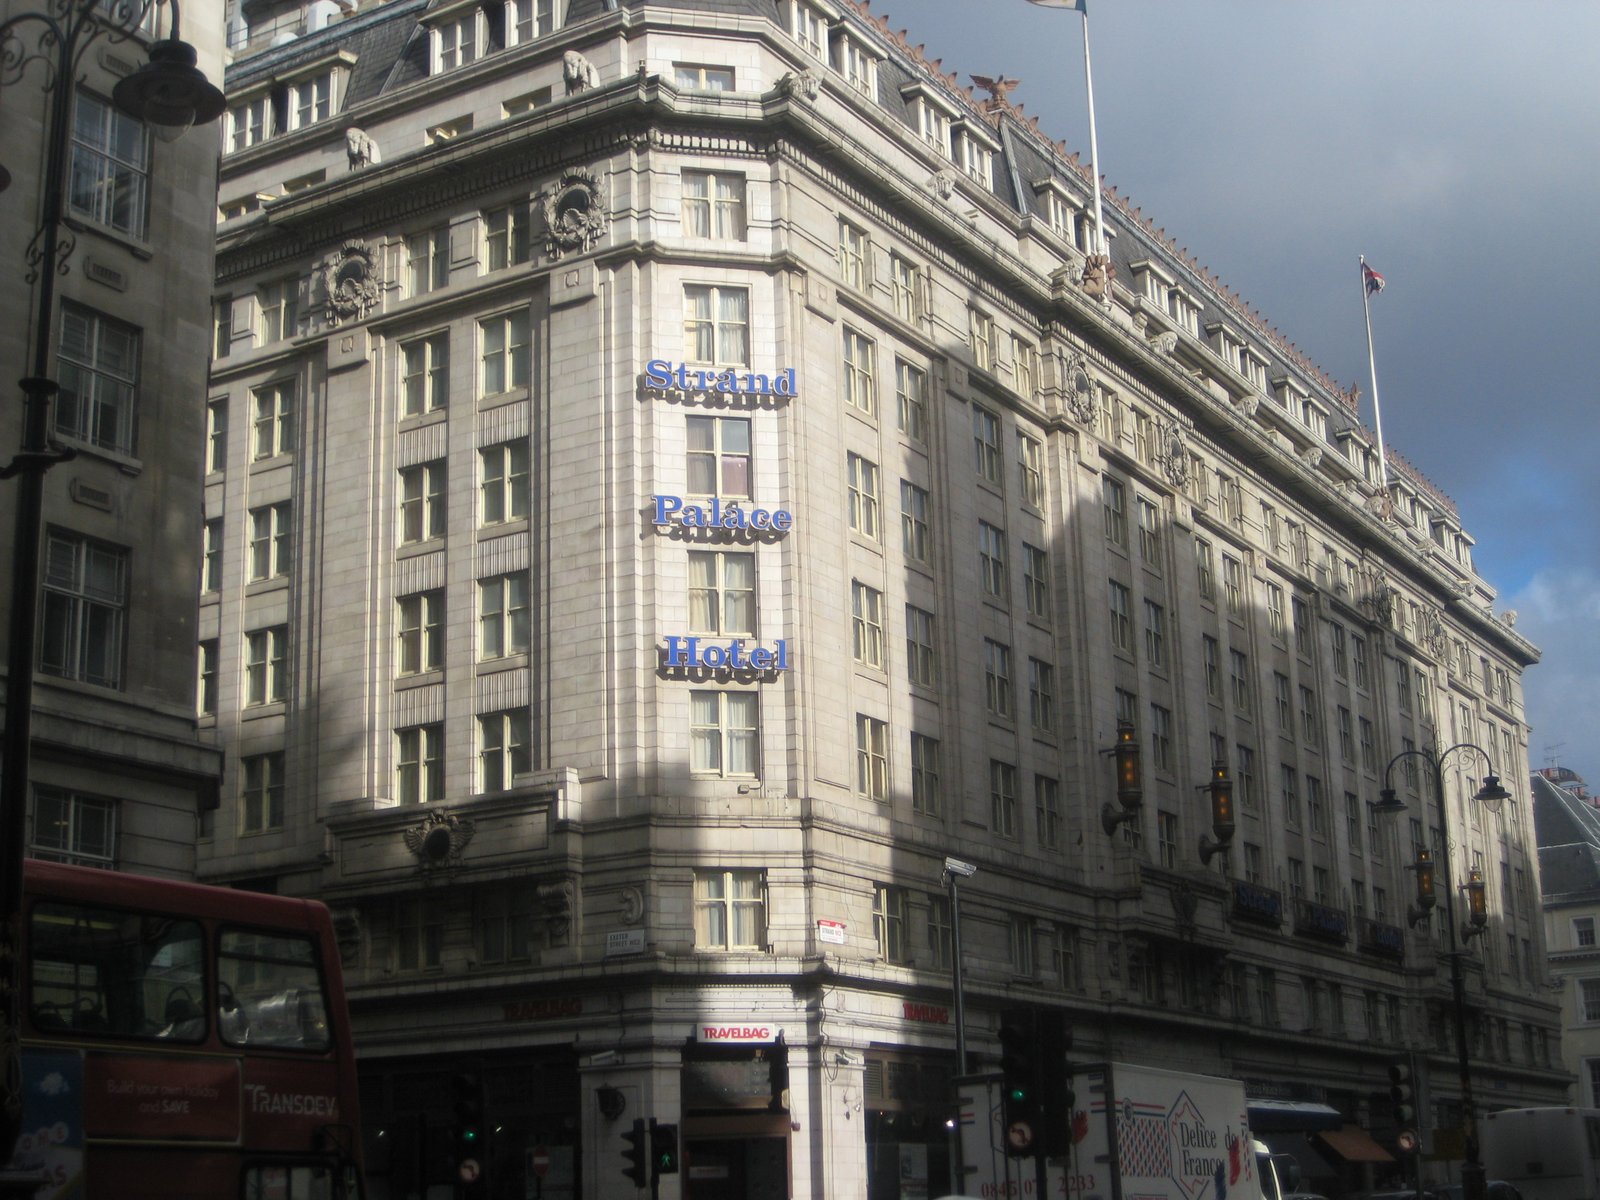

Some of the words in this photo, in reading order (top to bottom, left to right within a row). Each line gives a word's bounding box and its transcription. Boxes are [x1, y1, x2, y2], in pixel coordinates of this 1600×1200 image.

[645, 359, 798, 397] Strand
[651, 495, 792, 532] Palace
[663, 635, 788, 671] Hotel
[703, 1027, 770, 1039] TRAVELBAG
[138, 1100, 160, 1113] and
[161, 1100, 190, 1113] SAVE
[1180, 1121, 1217, 1148] Delice
